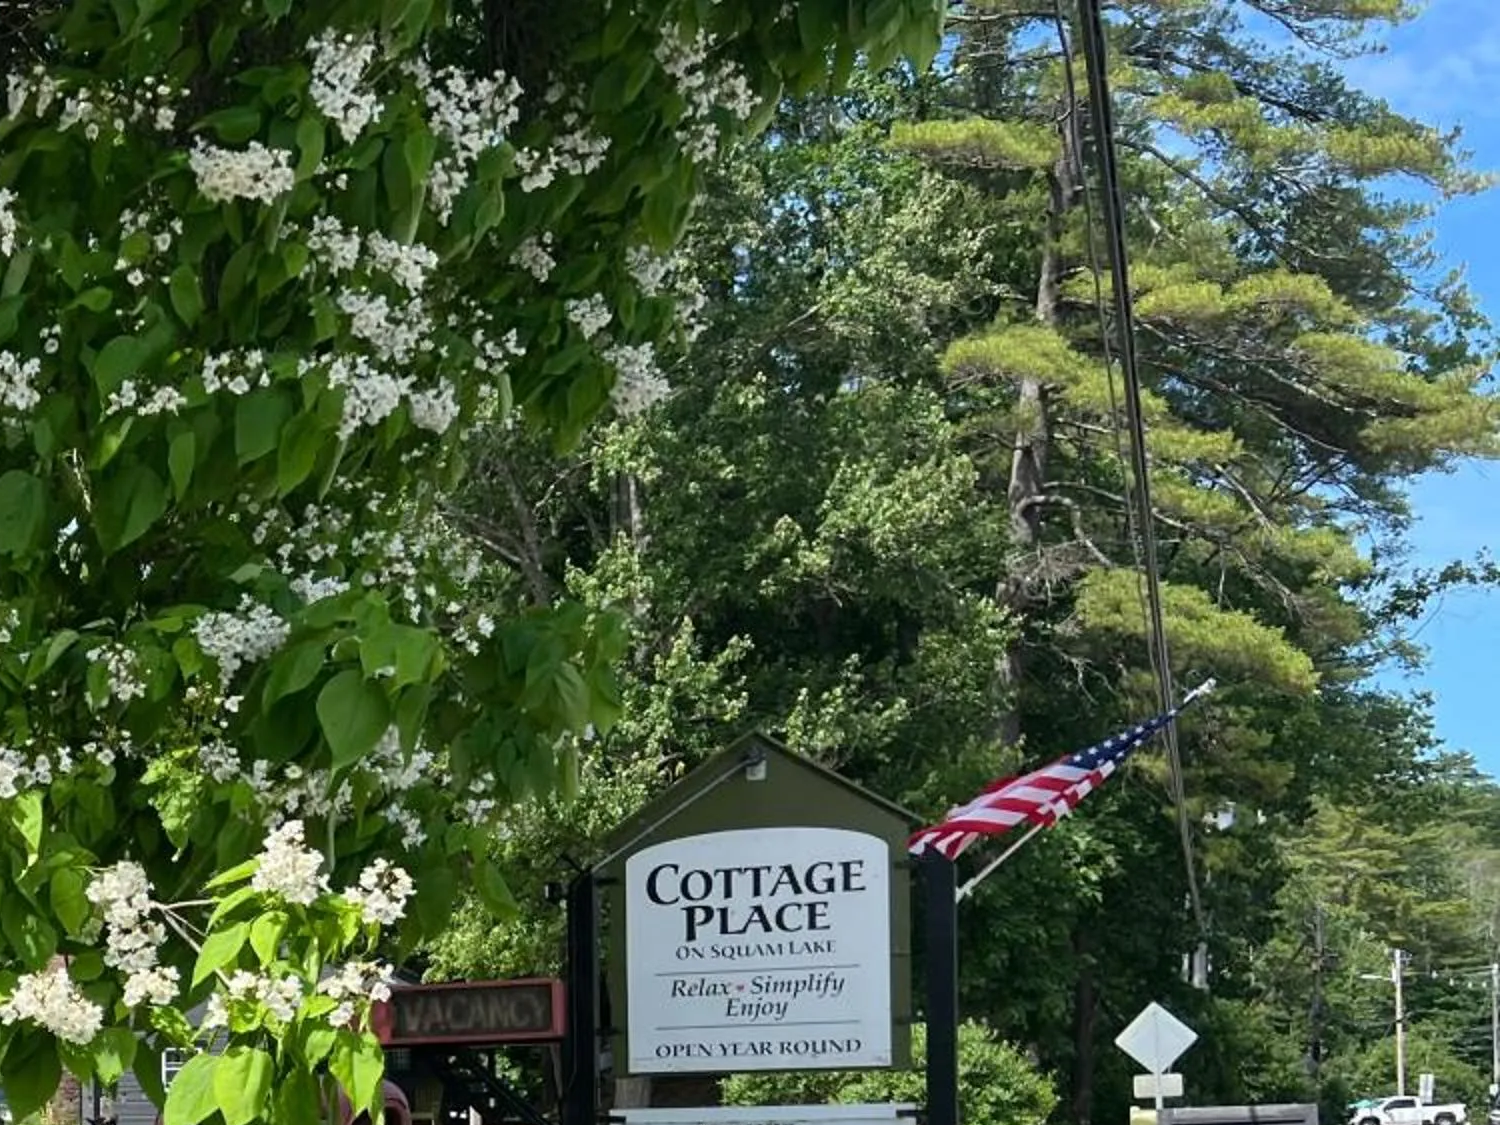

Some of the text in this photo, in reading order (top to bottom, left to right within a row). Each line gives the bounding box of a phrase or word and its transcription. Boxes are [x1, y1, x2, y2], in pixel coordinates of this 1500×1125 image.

[646, 860, 867, 905] COTTAGE
[681, 902, 831, 942] PLACE
[676, 940, 836, 960] ON SQUAM LAKE
[671, 971, 845, 998] Relax Simplify
[403, 992, 546, 1032] VACANCY
[726, 998, 788, 1021] Enjoy
[655, 1038, 862, 1058] OPEN YEAR ROUND
